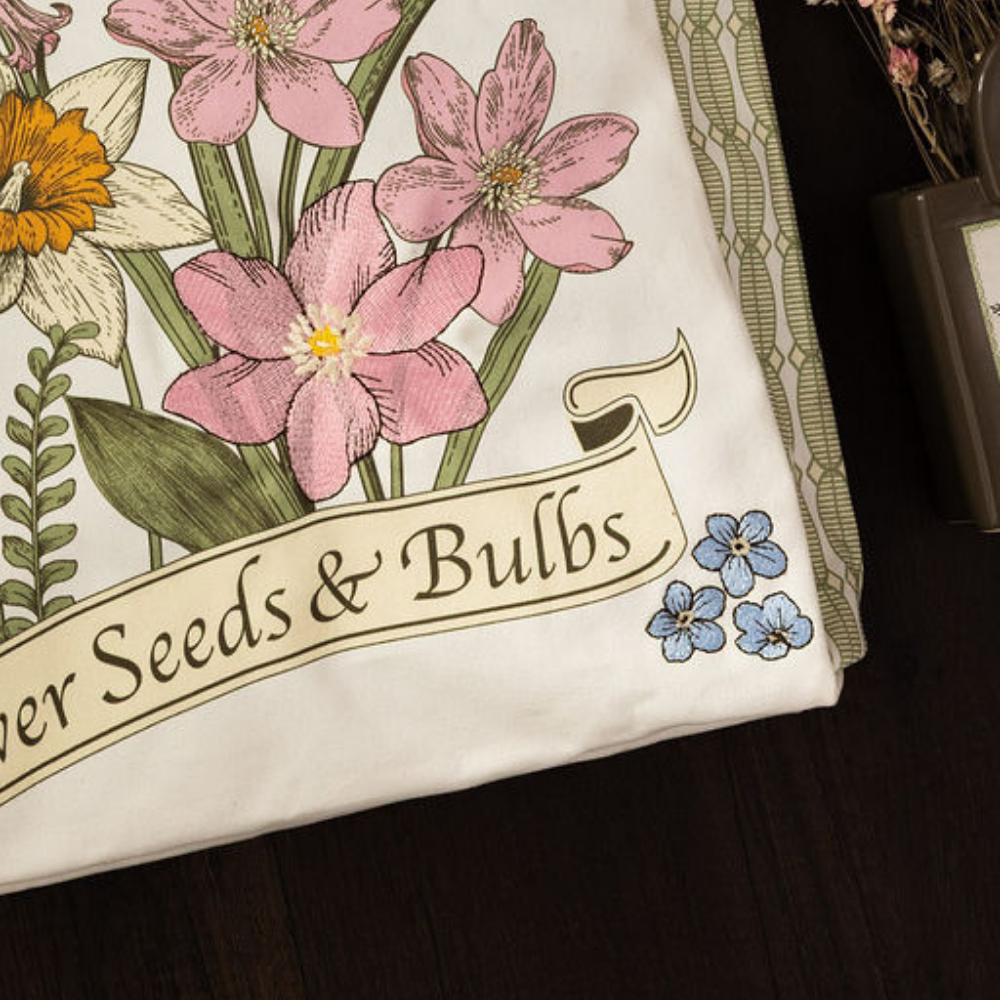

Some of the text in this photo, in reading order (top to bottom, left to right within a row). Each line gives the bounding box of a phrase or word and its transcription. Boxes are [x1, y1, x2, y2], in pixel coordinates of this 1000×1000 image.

[90, 555, 292, 706] Seeds
[310, 548, 382, 618] &
[400, 486, 633, 600] Bulbs
